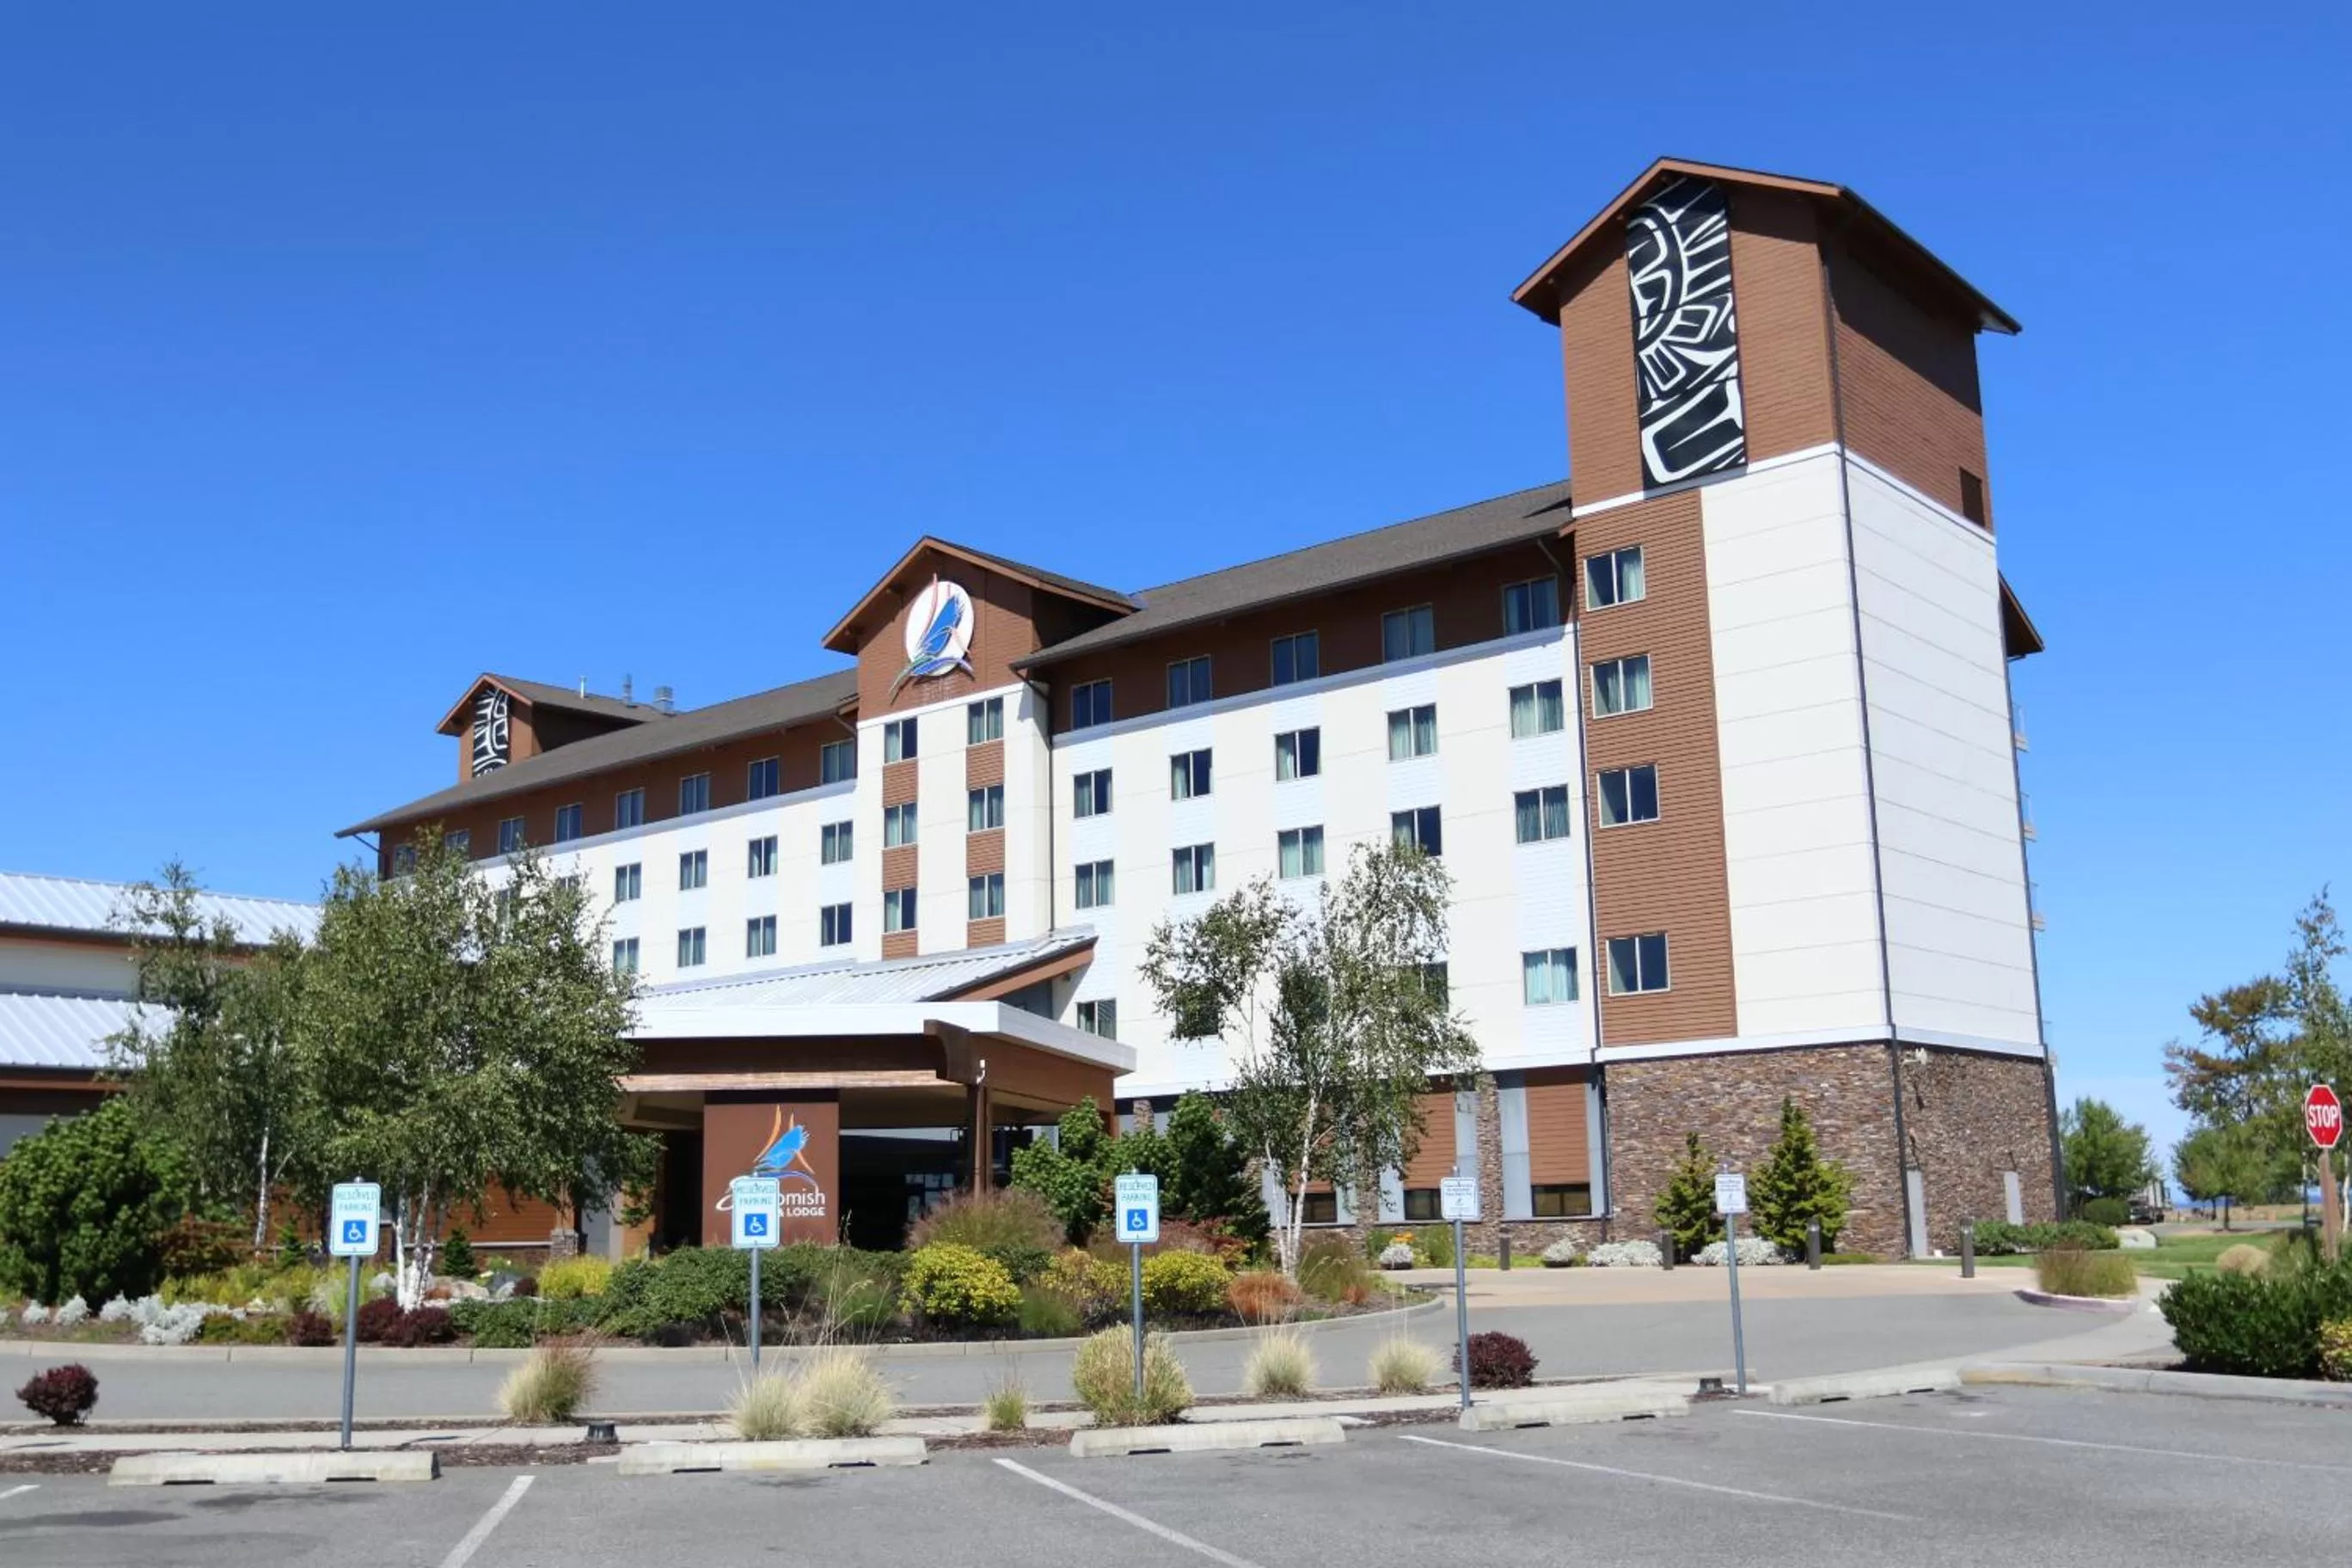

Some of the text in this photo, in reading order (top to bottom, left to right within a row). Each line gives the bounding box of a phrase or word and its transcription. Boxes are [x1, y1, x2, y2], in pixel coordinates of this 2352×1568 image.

[2309, 1105, 2338, 1128] STOP
[736, 1185, 775, 1194] RESERVED
[1119, 1182, 1155, 1191] RESERVED
[336, 1191, 377, 1200] RESERVED
[1120, 1193, 1153, 1202] PARKING
[739, 1197, 772, 1205] PARKING
[339, 1203, 372, 1211] PARKING
[786, 1206, 825, 1216] LODGE
